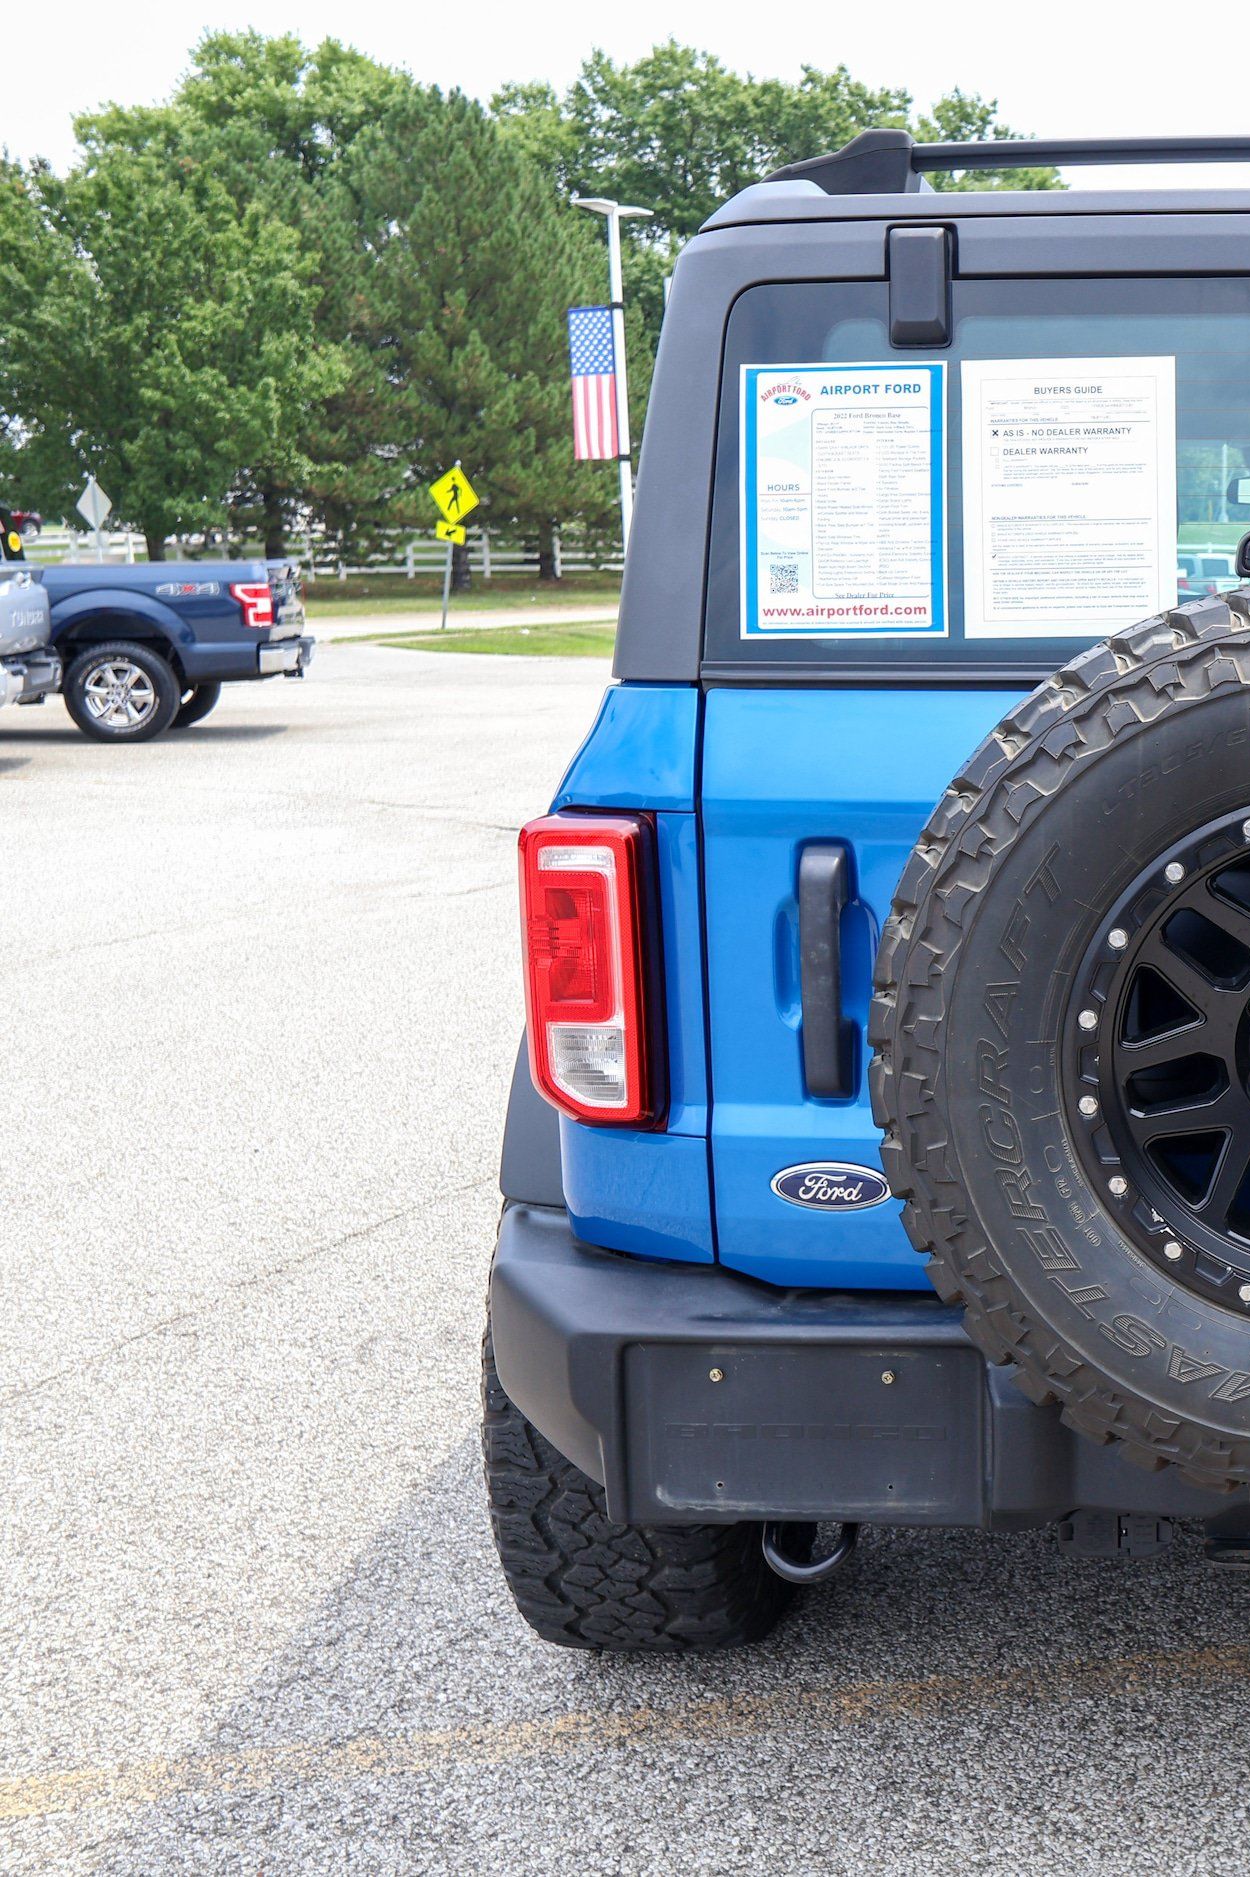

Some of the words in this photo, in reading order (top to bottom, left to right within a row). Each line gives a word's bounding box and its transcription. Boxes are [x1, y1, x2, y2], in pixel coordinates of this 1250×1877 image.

[760, 385, 791, 402] AIRPORT
[792, 386, 812, 401] FORD
[820, 384, 880, 395] AIRPORT
[884, 383, 922, 394] FORD
[1033, 386, 1072, 395] BUYERS
[1074, 385, 1103, 394] GUIDE
[848, 411, 863, 419] Ford
[1003, 429, 1014, 437] AS
[1016, 429, 1024, 437] IS
[1046, 428, 1081, 436] DEALER
[1083, 427, 1132, 435] WARRANTY
[1002, 448, 1037, 456] DEALER
[1039, 447, 1088, 455] WARRANTY
[767, 483, 800, 492] HOURS
[762, 604, 927, 619] www.airportford.com
[798, 1173, 864, 1201] Ford
